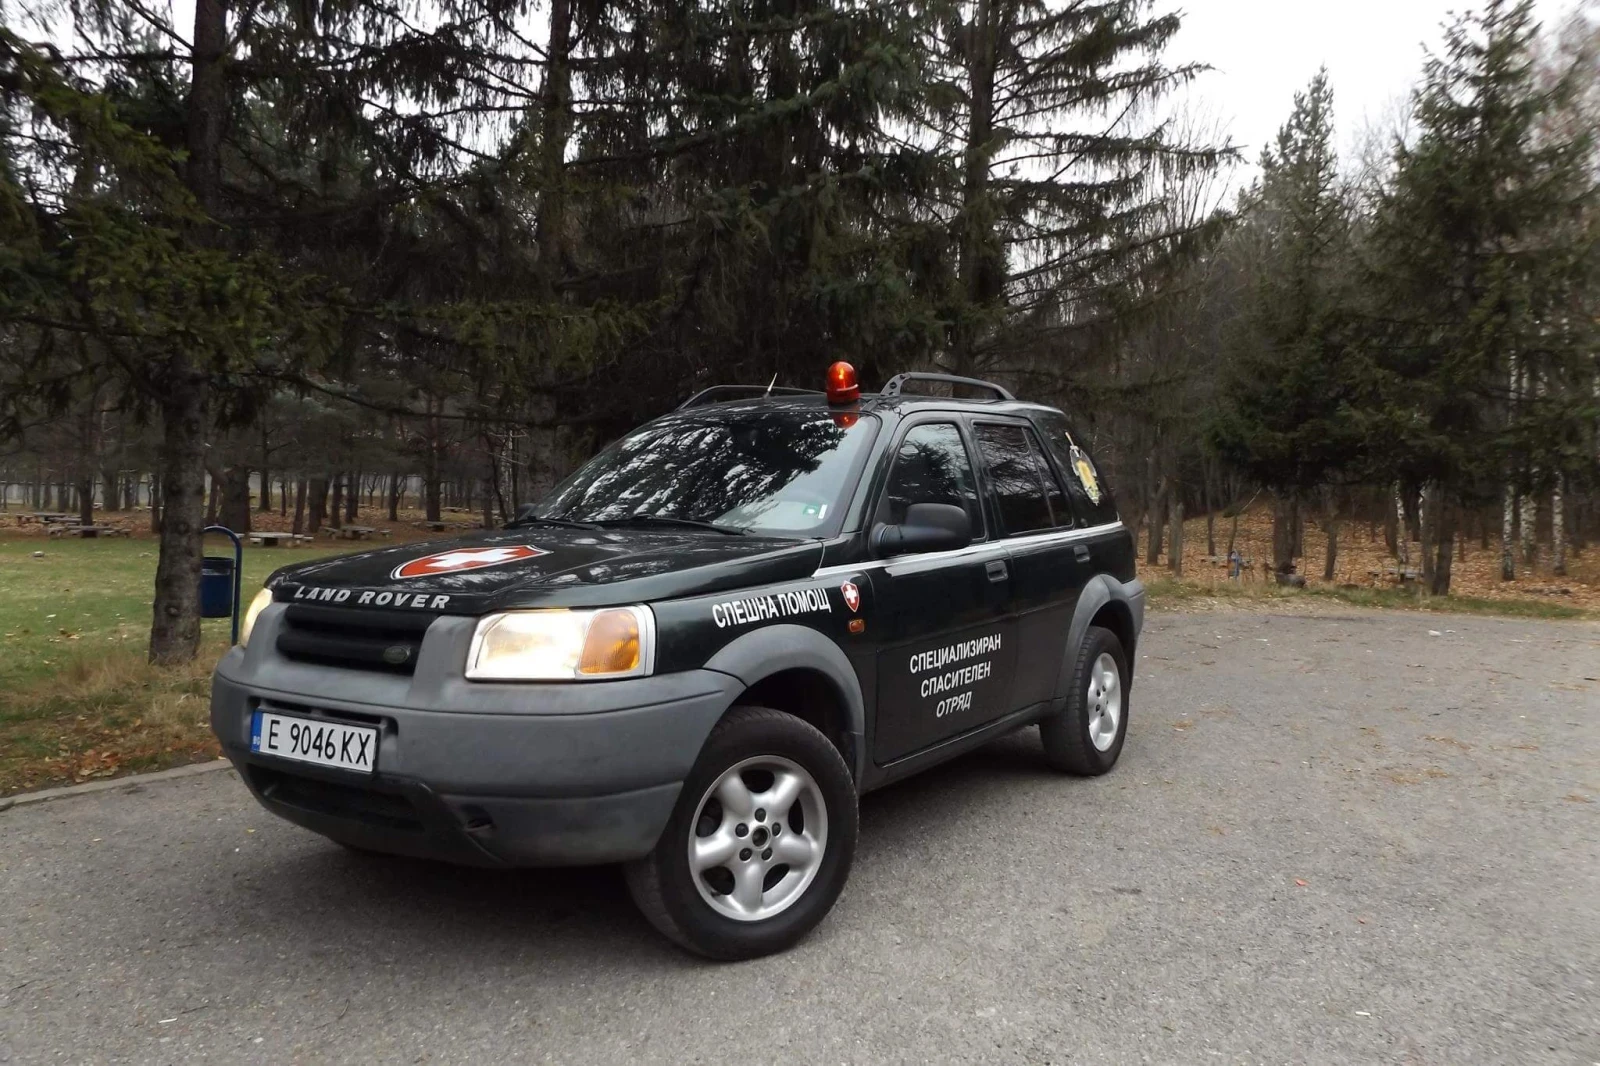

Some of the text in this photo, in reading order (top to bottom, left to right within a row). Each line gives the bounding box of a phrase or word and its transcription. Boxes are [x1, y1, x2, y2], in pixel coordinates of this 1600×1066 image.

[294, 586, 450, 609] LAND ROVER
[712, 588, 832, 628] СПЕШНА ПОМОЩ
[909, 633, 1002, 674] СПЕЦИАЛИЗИРАН
[921, 661, 991, 698] СПАСИТЕЛЕН
[936, 691, 972, 718] ОТРЯД
